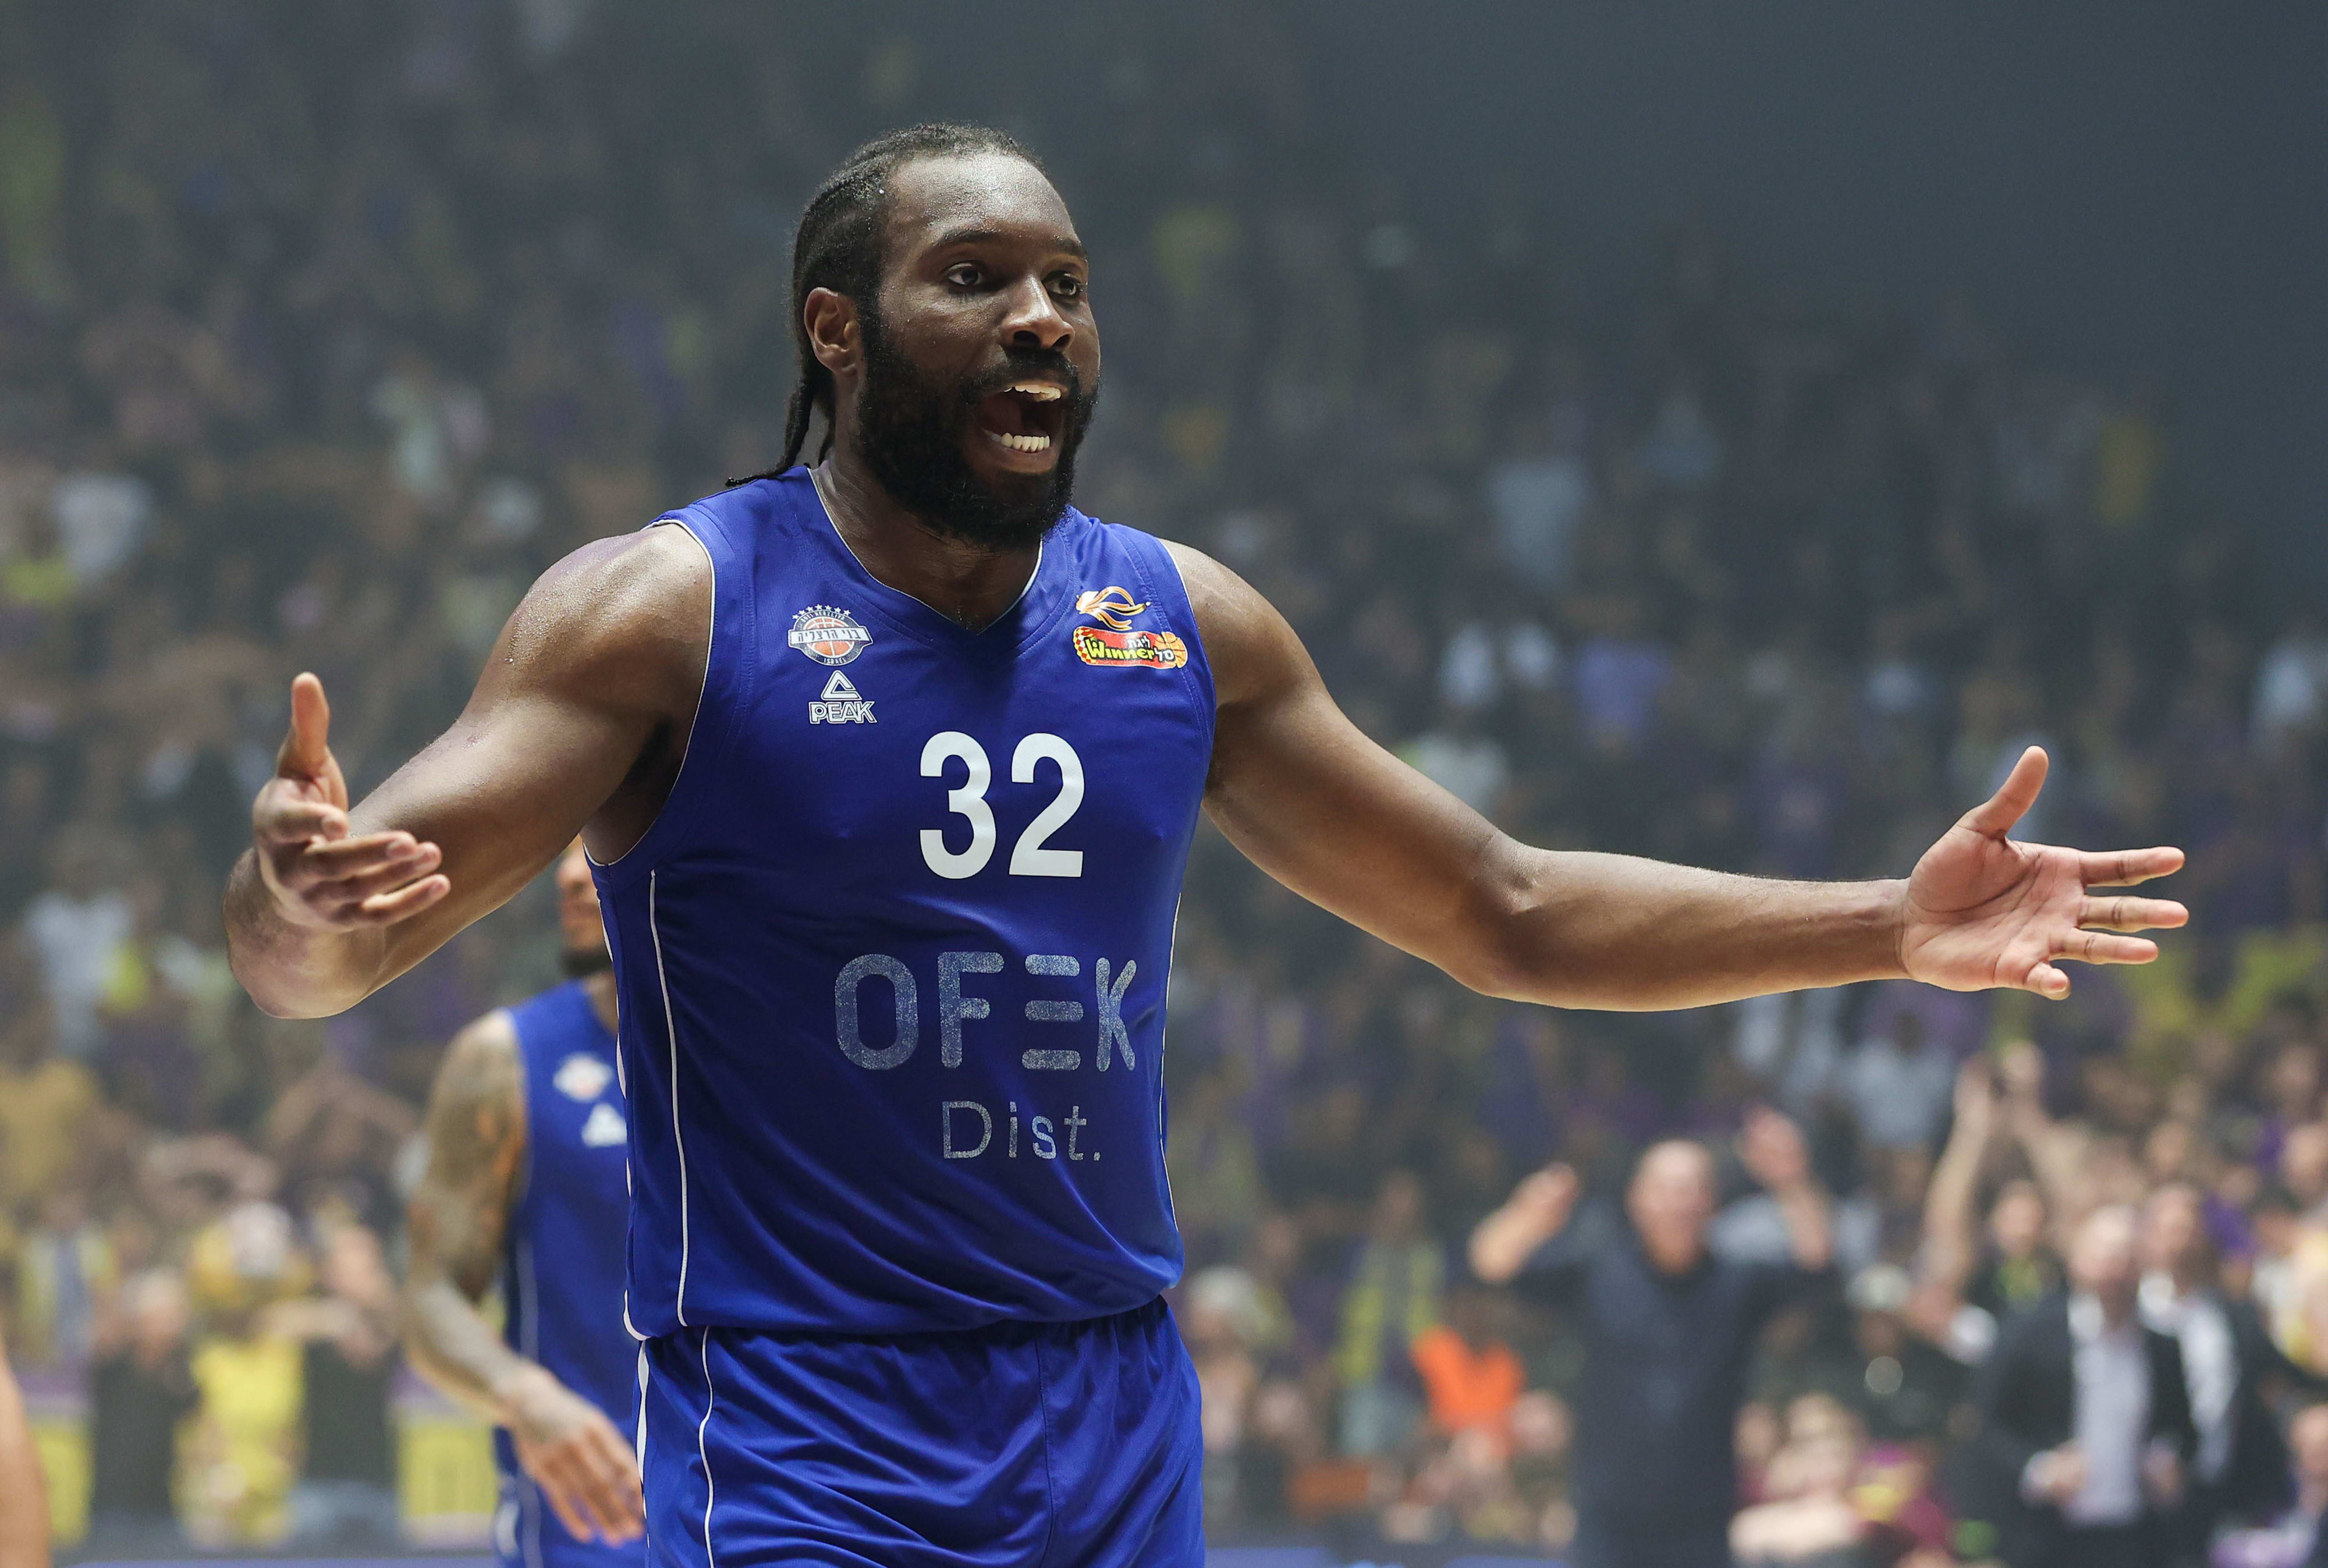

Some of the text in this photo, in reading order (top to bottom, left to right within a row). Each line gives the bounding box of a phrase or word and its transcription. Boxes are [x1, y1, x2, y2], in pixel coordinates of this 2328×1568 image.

[798, 629, 861, 642] בני הרצליה
[1127, 634, 1151, 648] ליגת
[1084, 638, 1155, 659] Winner
[808, 701, 877, 725] PEAK
[920, 731, 1085, 879] 32
[834, 951, 1137, 1072] OFEK
[942, 1100, 1101, 1161] Dist.
